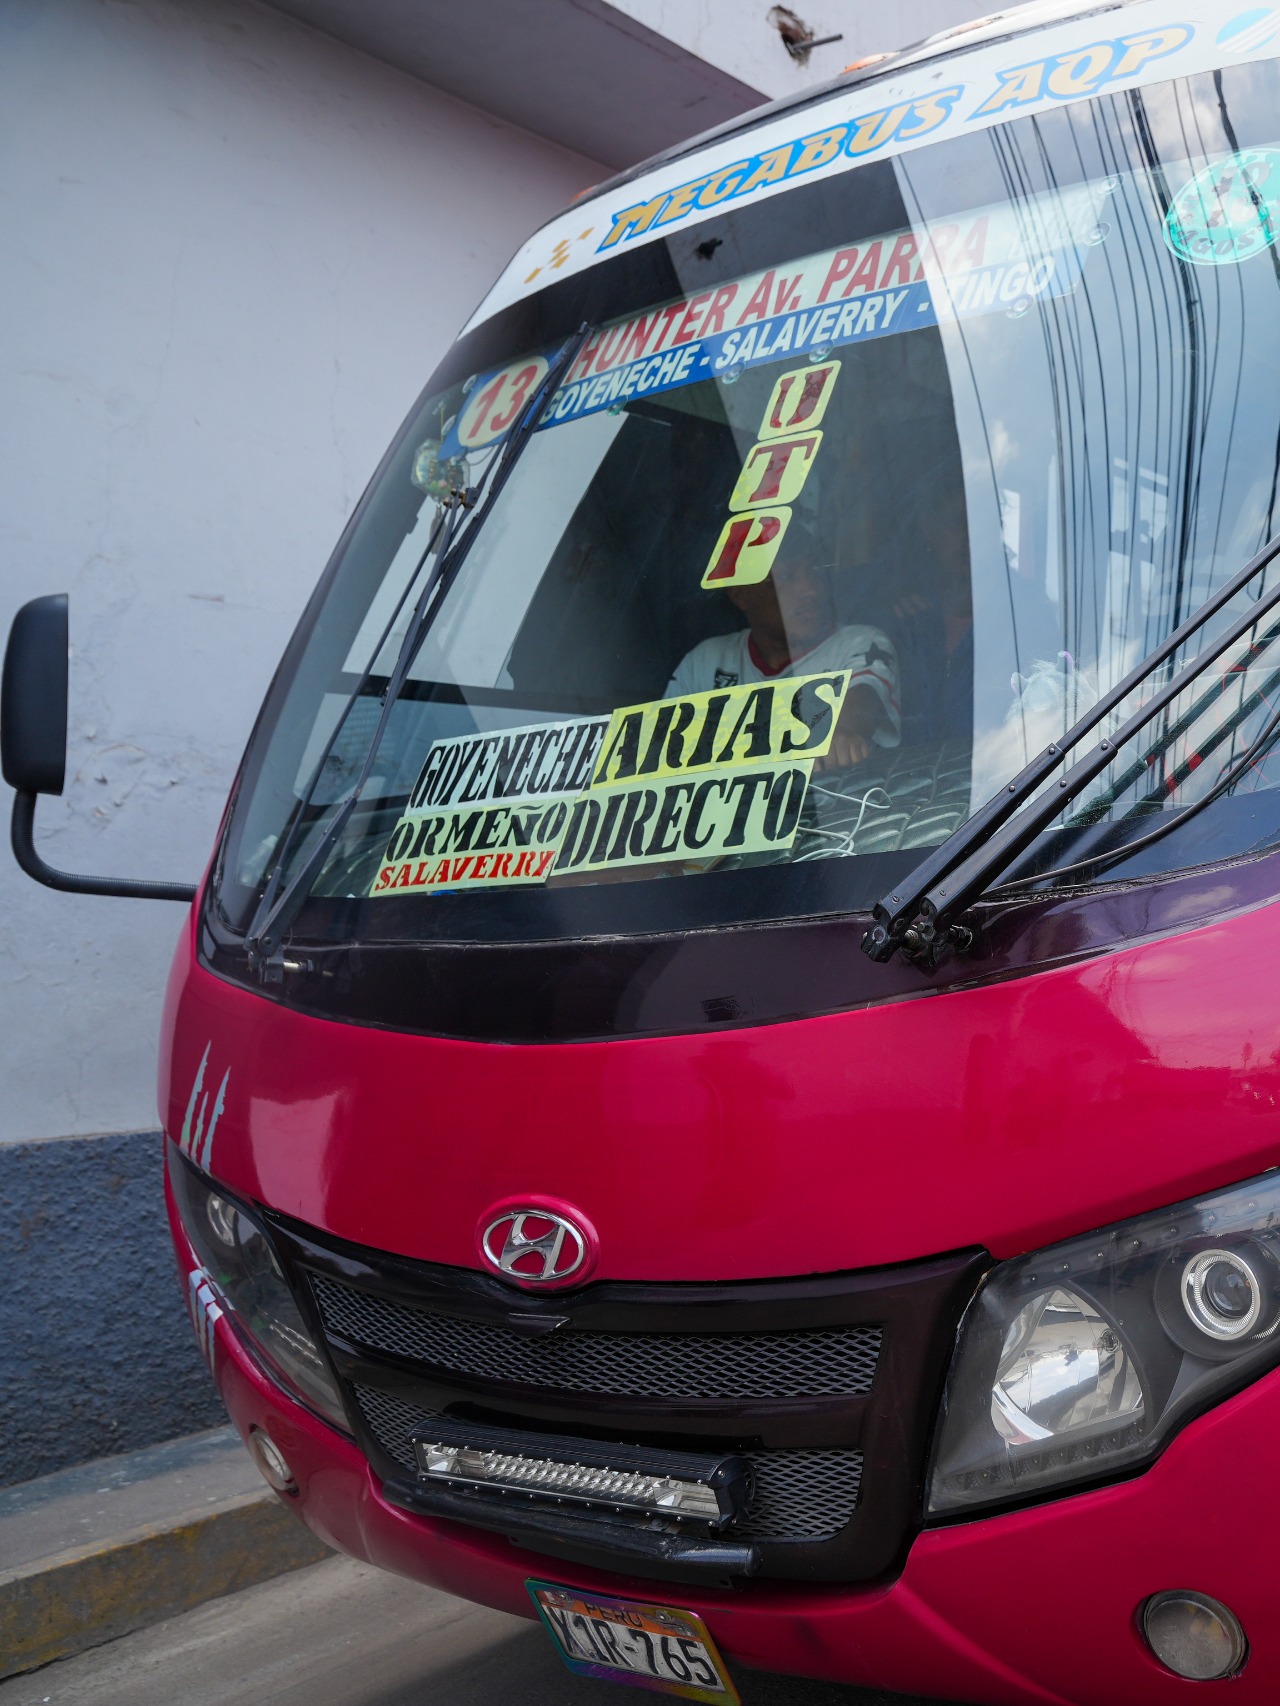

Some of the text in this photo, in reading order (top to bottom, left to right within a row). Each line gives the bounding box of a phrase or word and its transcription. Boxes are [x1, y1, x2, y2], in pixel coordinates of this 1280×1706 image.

[596, 85, 966, 253] MEGABUS
[966, 22, 1197, 122] AQP
[539, 344, 700, 425] GOYENECHE
[714, 290, 908, 370] SALAVERRY
[942, 256, 1056, 317] TINGO
[564, 282, 740, 384] HUNTER
[737, 269, 801, 327] Av.
[817, 216, 990, 297] PARRA
[467, 365, 538, 440] 13
[409, 720, 612, 809] GOYENECHE
[593, 674, 844, 785] ARIAS
[386, 800, 568, 862] ORMEÑO
[554, 769, 808, 871] DIRECTO
[374, 850, 555, 891] SALAVERRY
[546, 1605, 719, 1687] X1R-765
[584, 1602, 643, 1628] PERU
